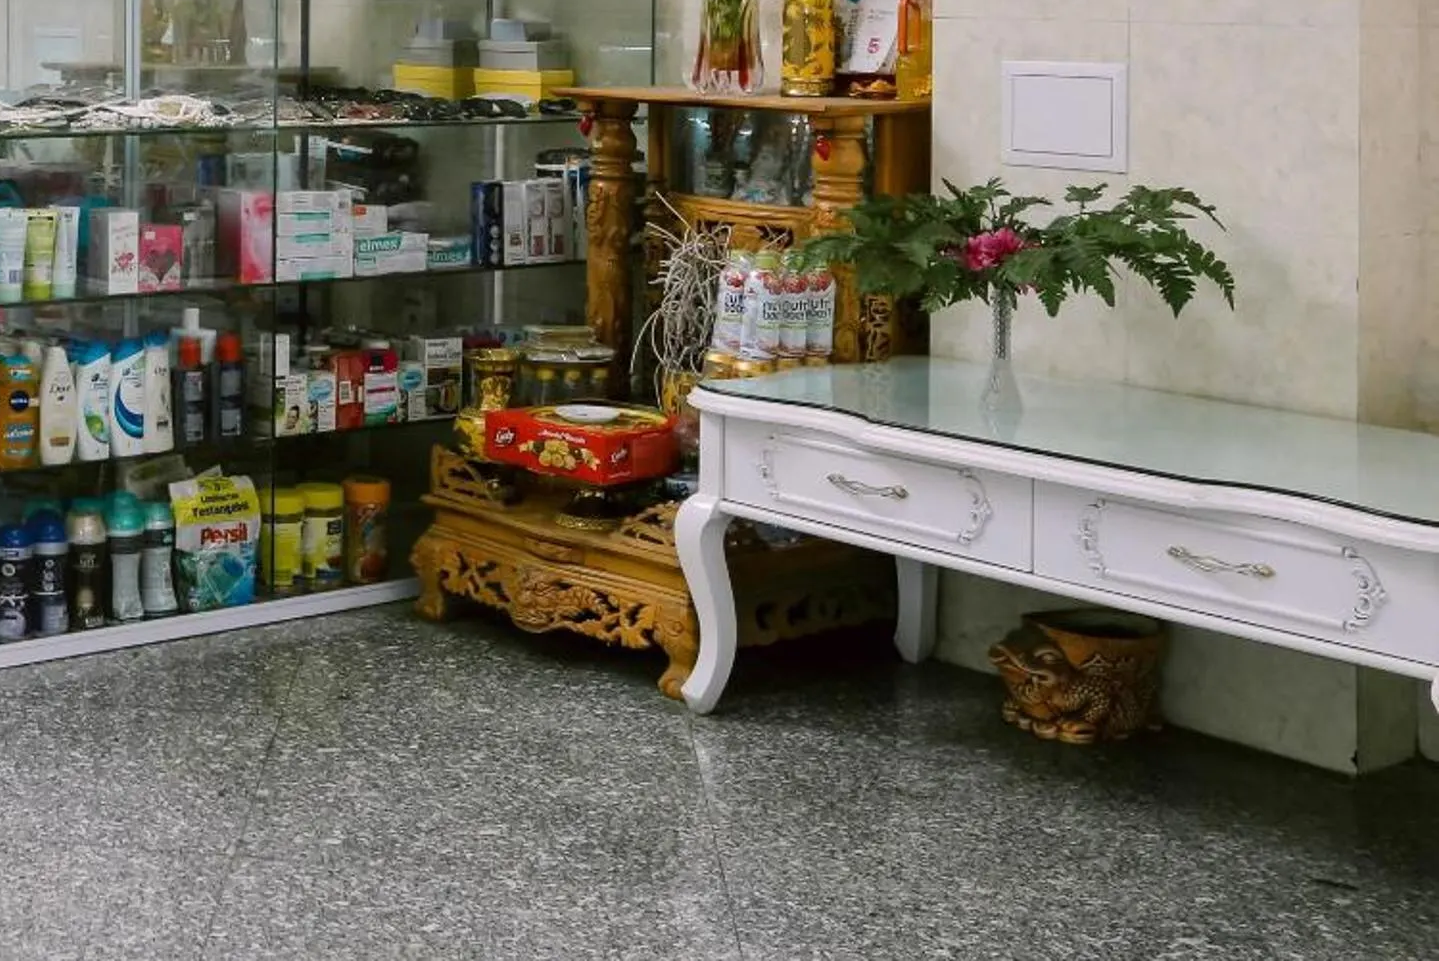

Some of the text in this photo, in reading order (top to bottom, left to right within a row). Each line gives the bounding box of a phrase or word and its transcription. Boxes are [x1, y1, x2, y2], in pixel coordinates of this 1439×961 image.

[867, 37, 880, 54] 5
[359, 239, 400, 253] elmex
[200, 520, 248, 545] Persil
